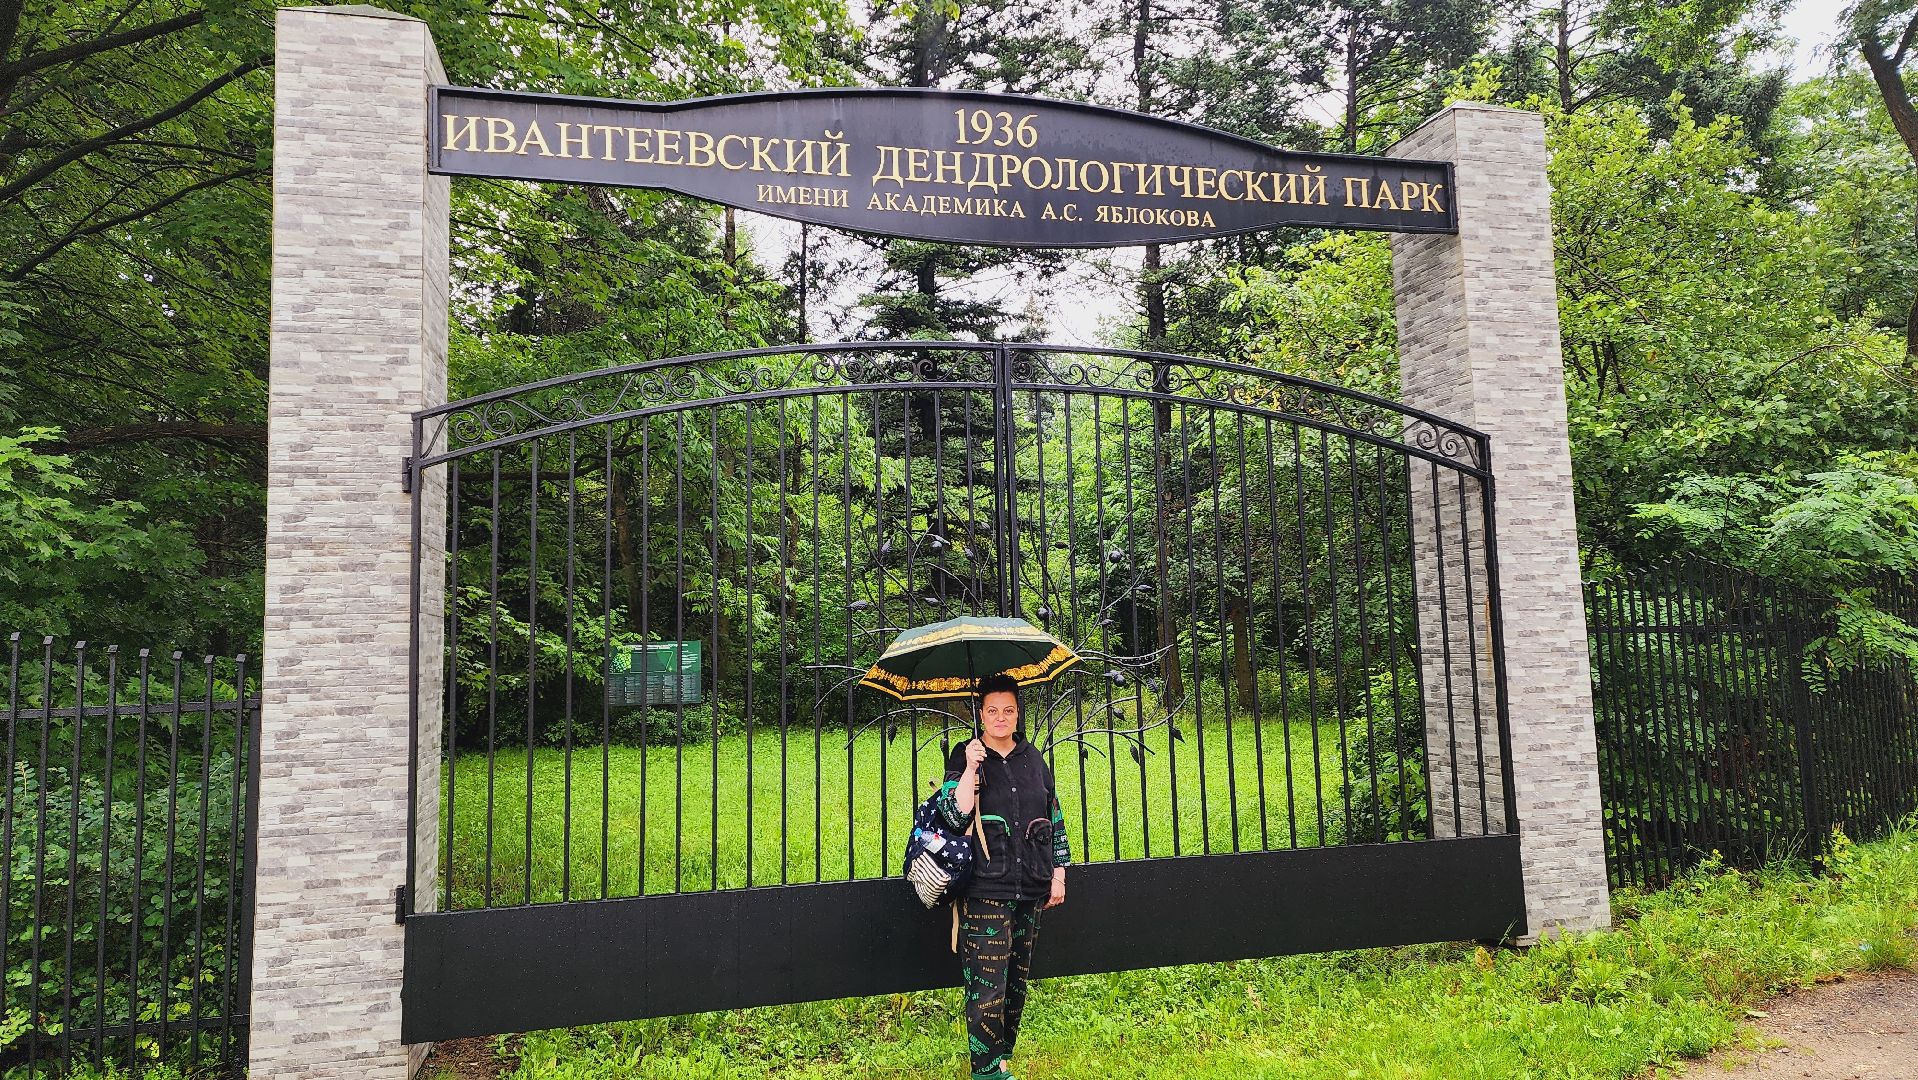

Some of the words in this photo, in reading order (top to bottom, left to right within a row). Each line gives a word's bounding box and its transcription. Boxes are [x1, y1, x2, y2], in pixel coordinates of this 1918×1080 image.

[954, 108, 1038, 147] 1936
[442, 113, 851, 177] ИВАНТЕЕВСКИЙ
[872, 146, 1329, 207] ДЕНДРОЛОГИЧЕСКИЙ
[1344, 177, 1448, 214] ПАРК
[757, 184, 849, 208] ИМЕНИ
[866, 194, 1026, 218] АКАДЕМИКА
[1040, 203, 1083, 222] А.С.
[1095, 206, 1216, 228] ЯБЛОКОВА
